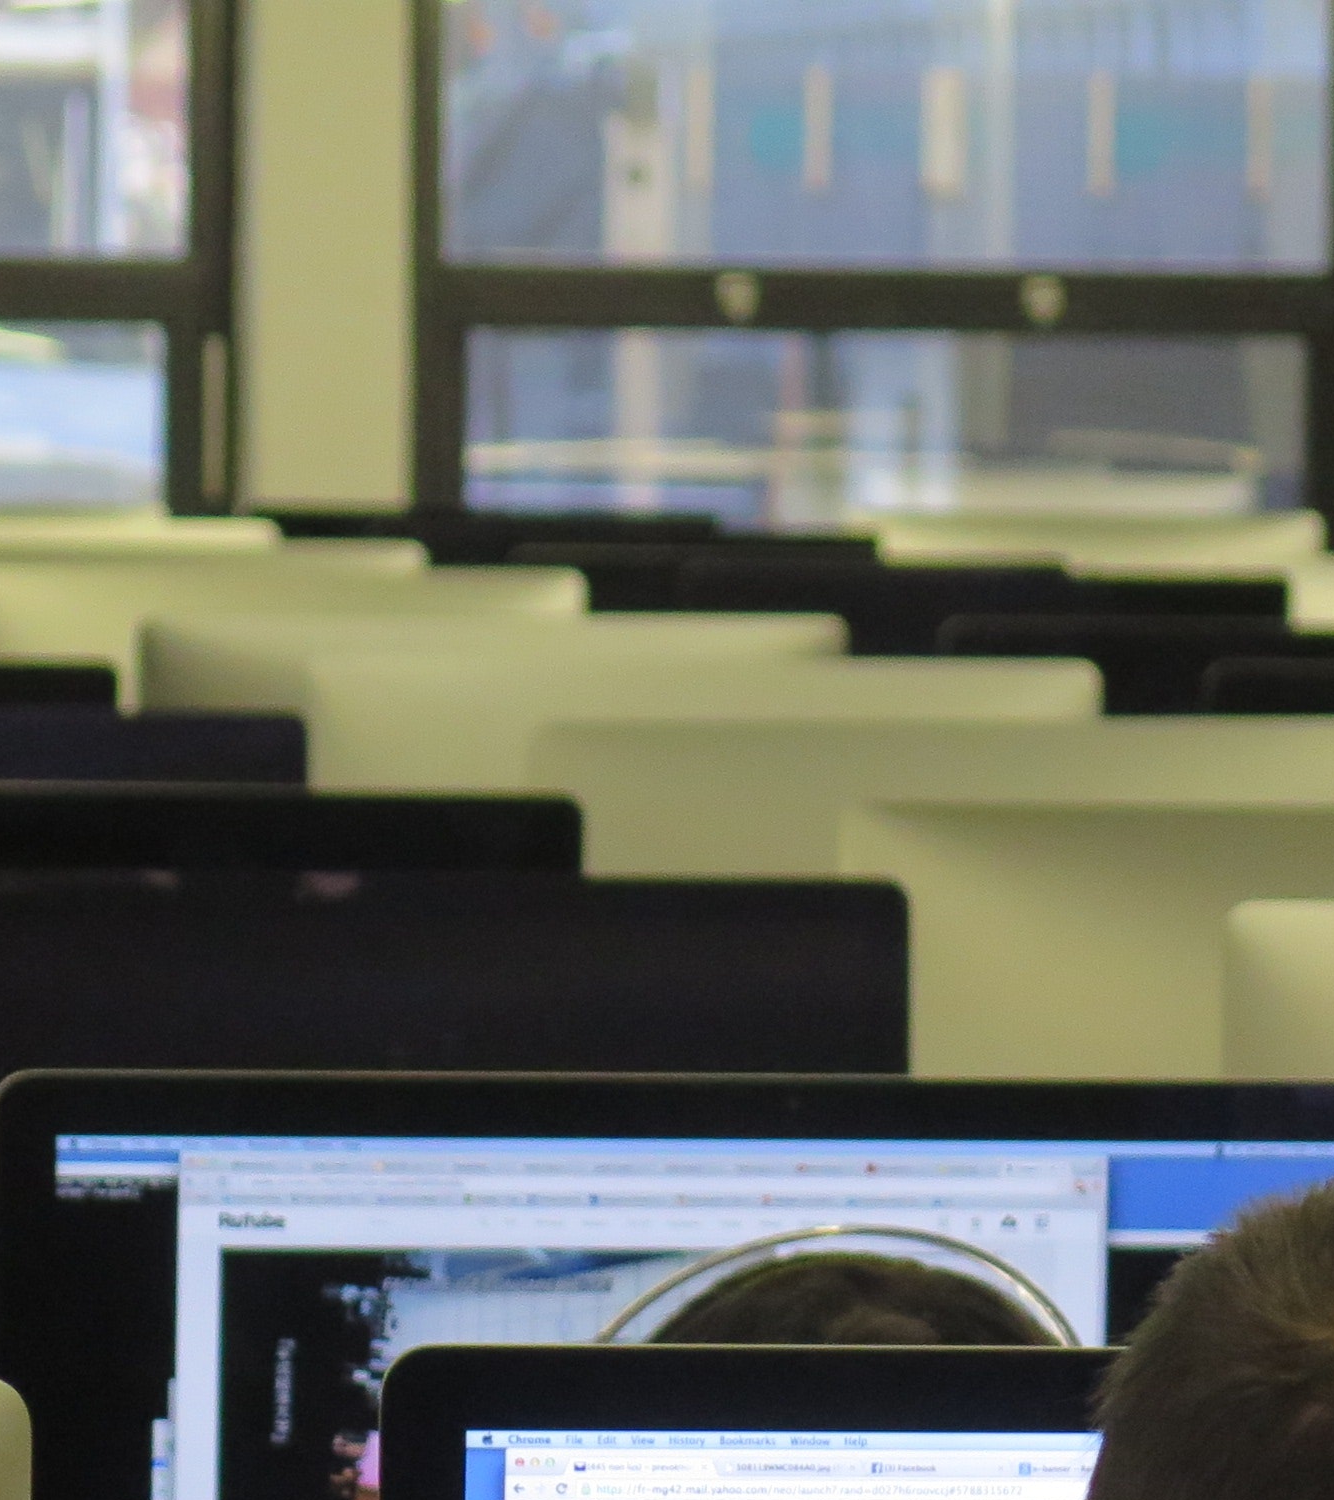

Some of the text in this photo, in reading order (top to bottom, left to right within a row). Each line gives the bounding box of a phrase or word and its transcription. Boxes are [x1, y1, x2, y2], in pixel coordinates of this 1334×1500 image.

[507, 1435, 867, 1448] Chrome File Edit View History Bookmarks Window Help
